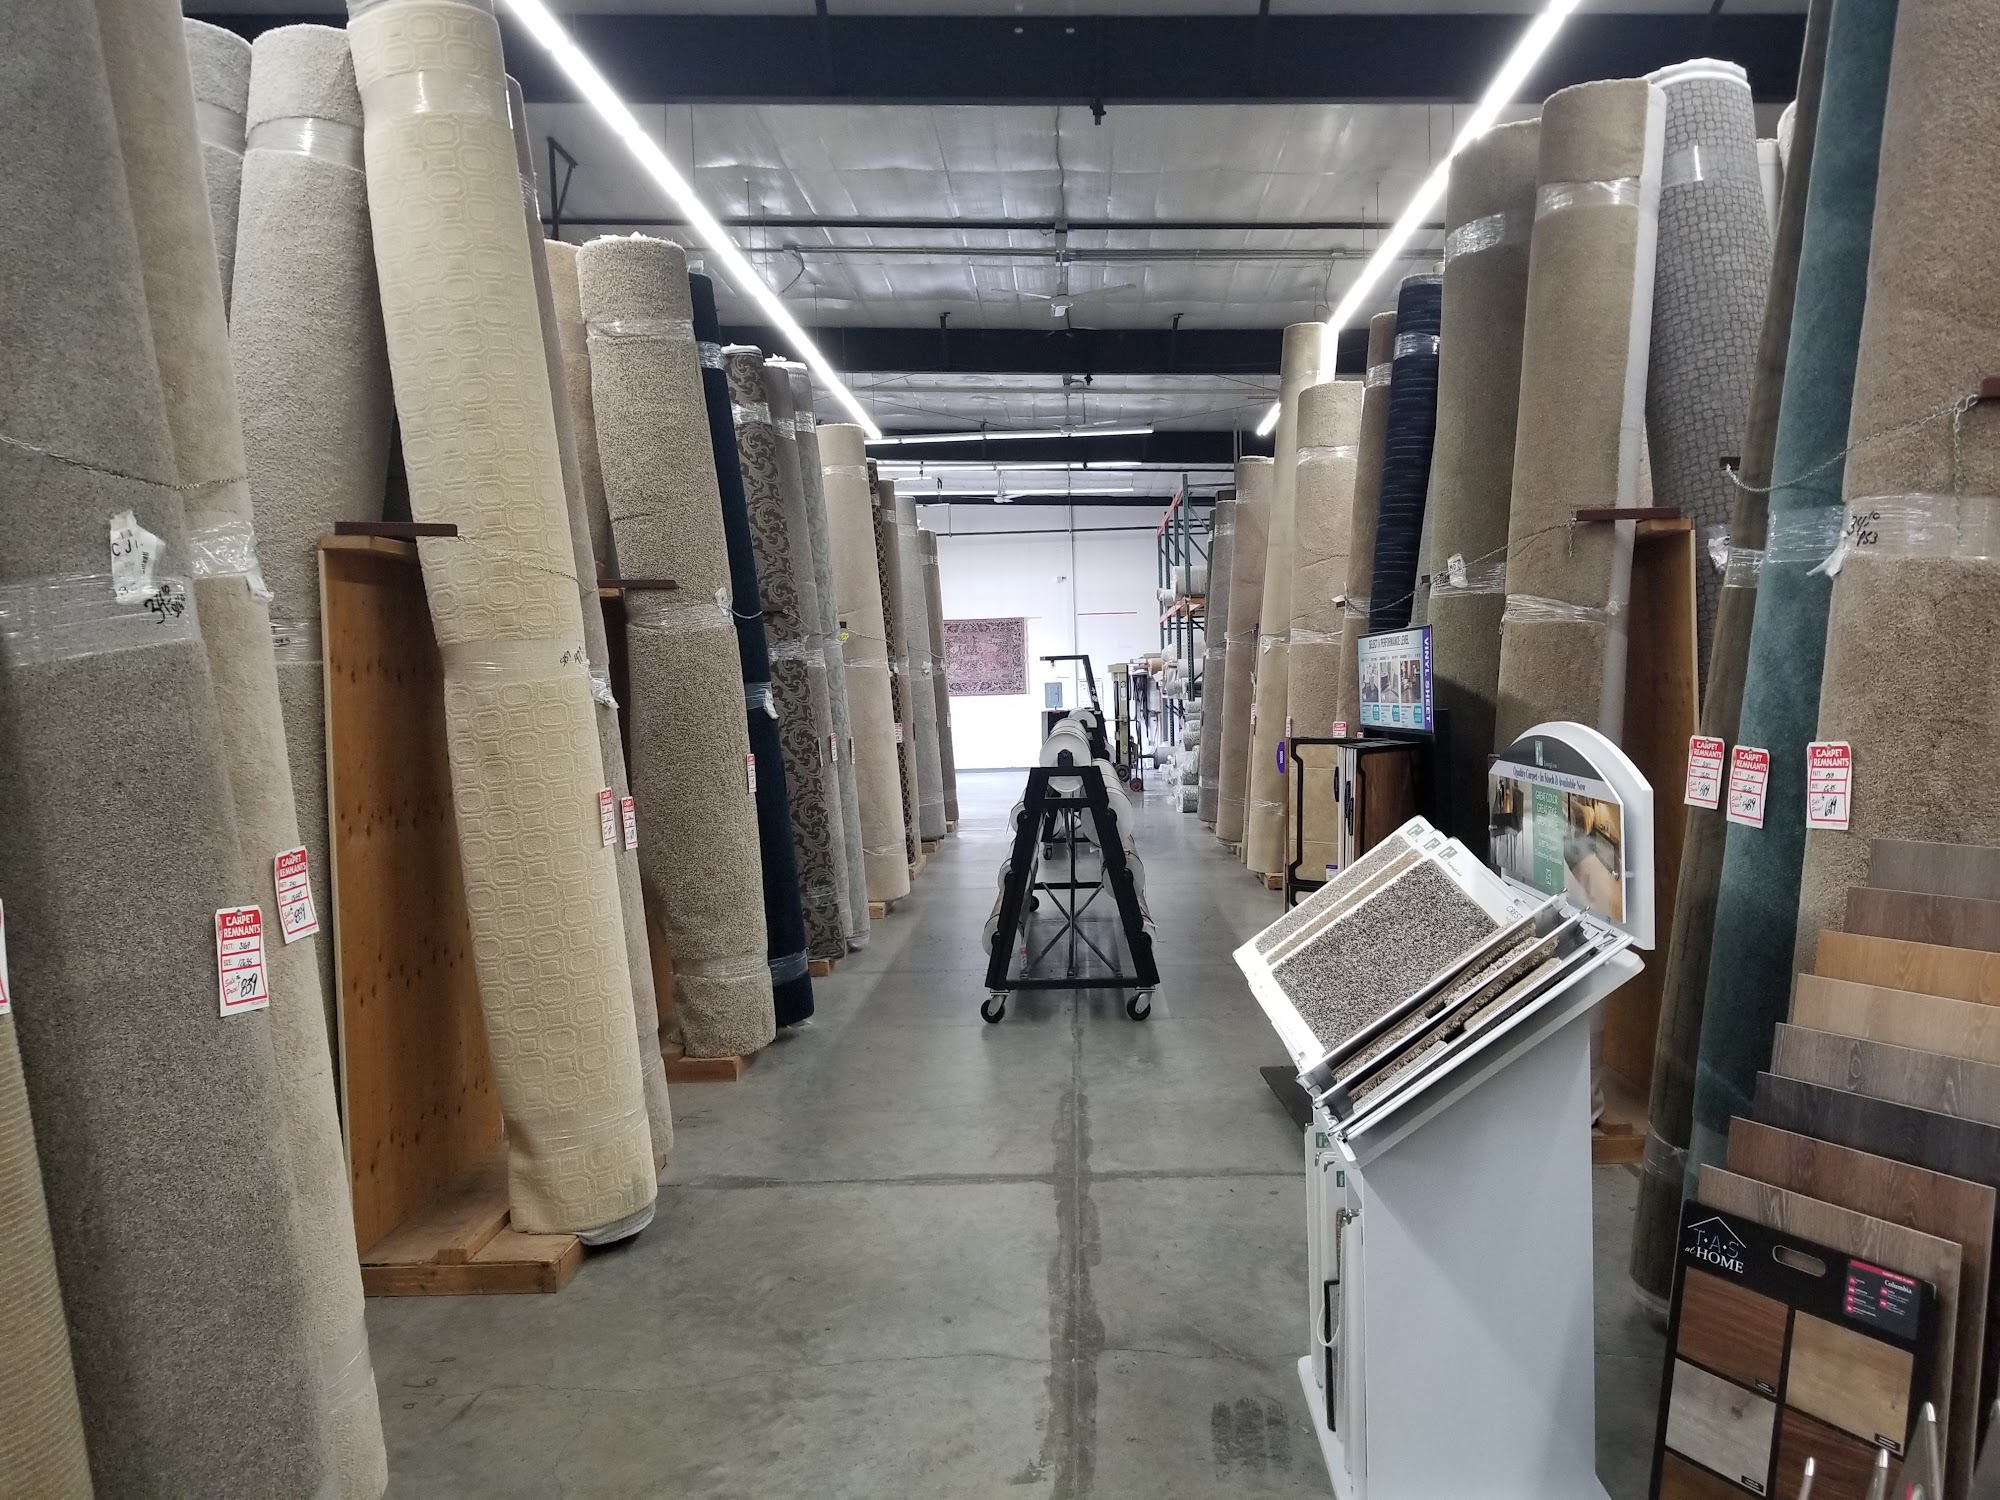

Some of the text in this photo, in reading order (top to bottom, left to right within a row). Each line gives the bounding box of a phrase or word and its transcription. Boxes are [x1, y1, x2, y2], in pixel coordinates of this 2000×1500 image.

[1696, 741, 1718, 751] CARPET
[1815, 748, 1843, 757] CARPET
[1693, 749, 1722, 759] REMNANTS
[1739, 752, 1763, 762] CARPET
[1736, 759, 1767, 771] REMNANTS
[1813, 757, 1849, 767] REMNANTS
[1512, 766, 1526, 780] Quality
[1526, 768, 1538, 783] Carpet
[1544, 772, 1554, 785] Stock
[1559, 776, 1576, 789] Available
[1576, 780, 1586, 791] Now
[281, 853, 302, 868] CARPET
[279, 861, 306, 876] REMNANTS
[225, 913, 255, 927] CARPET
[223, 924, 261, 938] REMNANTS
[1696, 1246, 1744, 1274] HOME
[1884, 1279, 1913, 1295] Columbia
